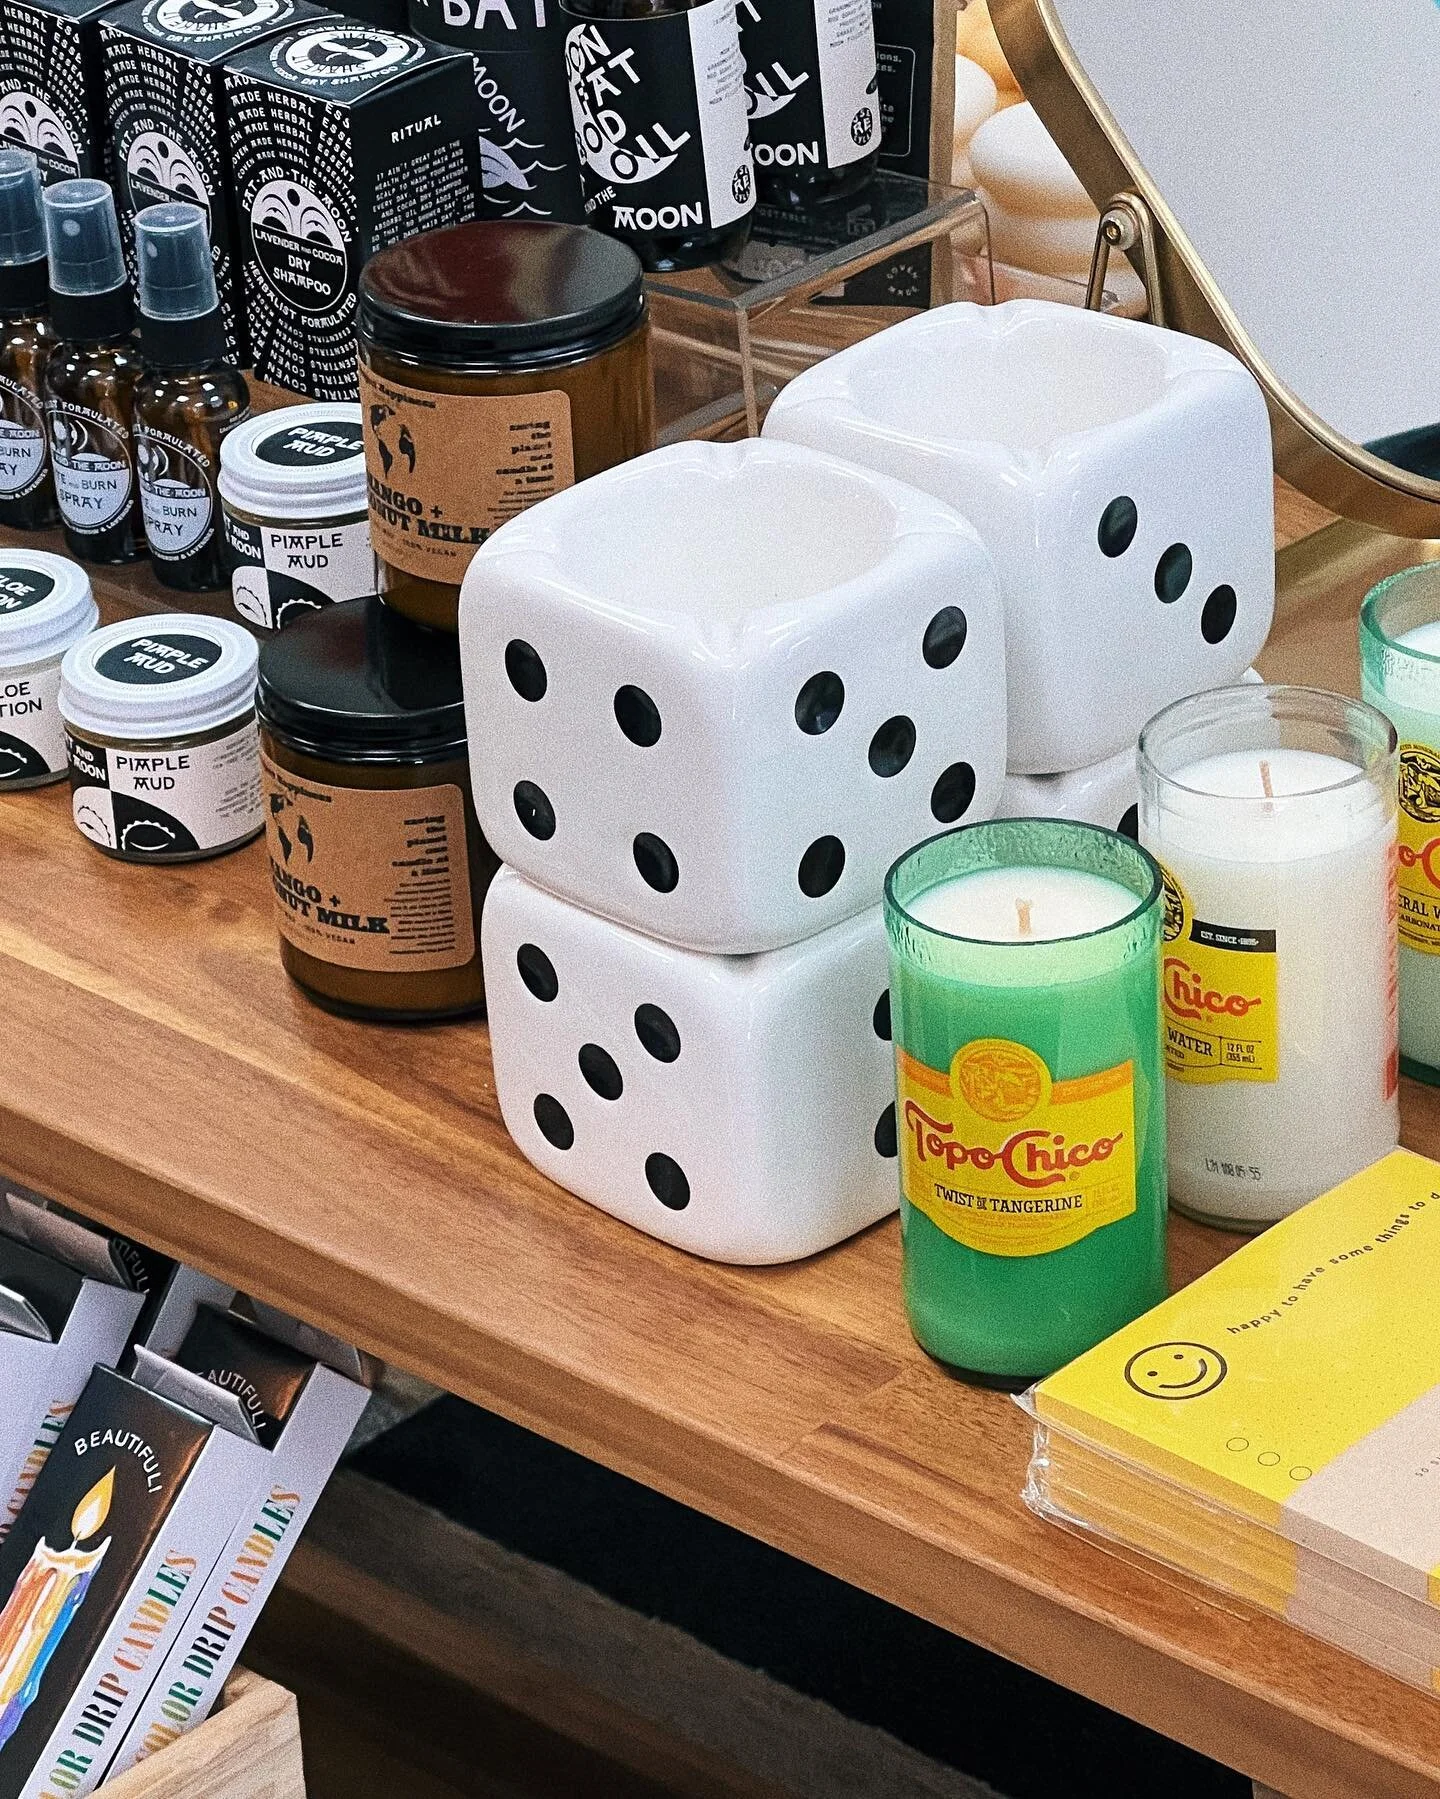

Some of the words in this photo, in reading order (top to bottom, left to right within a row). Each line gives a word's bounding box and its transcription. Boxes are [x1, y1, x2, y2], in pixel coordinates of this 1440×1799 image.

[4, 6, 48, 34] HERBAL
[7, 22, 46, 46] HERBAL
[10, 36, 45, 59] HERBAL
[106, 44, 133, 58] MADE
[137, 45, 179, 73] HERBAL
[330, 65, 399, 86] SHAMPOO
[230, 91, 262, 107] MADE
[267, 91, 315, 118] HERBAL
[27, 81, 51, 106] THE
[55, 106, 85, 155] MOON
[238, 107, 266, 122] MADE
[270, 108, 313, 132] HERBAL
[391, 114, 442, 143] RITUAL
[244, 121, 270, 135] MADE
[273, 122, 312, 145] HERBAL
[118, 130, 132, 162] FAT
[132, 118, 155, 134] AND
[160, 121, 184, 146] THE
[187, 147, 216, 197] MOON
[250, 137, 273, 149] MADE
[276, 137, 310, 157] HERBAL
[610, 122, 691, 180] OIL
[278, 151, 309, 169] HERBAL
[411, 153, 430, 167] GREAT
[242, 180, 257, 212] FAT
[259, 165, 284, 183] AND
[291, 168, 317, 193] THE
[322, 193, 353, 243] MOON
[376, 188, 396, 201] SCALP
[594, 185, 617, 205] THE
[612, 201, 704, 231] MOON
[254, 229, 300, 252] LAVENDER
[312, 248, 344, 266] COCOA
[288, 254, 311, 272] DRY
[273, 267, 332, 296] SHAMPOO
[248, 260, 297, 320] HERBALIST
[301, 292, 357, 329] FORMULATED
[275, 328, 304, 351] COVEN
[270, 349, 306, 378] COVEN
[272, 339, 305, 365] COVEN
[267, 361, 307, 393] COVEN
[62, 401, 130, 439] FORMULATED
[9, 429, 40, 439] MOON
[288, 428, 365, 451] PIMPLE
[144, 426, 211, 468] FORMULATED
[283, 440, 336, 457] MUD
[73, 461, 91, 470] THE
[94, 461, 127, 471] MOON
[81, 479, 117, 490] BURN
[153, 487, 171, 496] THE
[175, 487, 206, 497] MOON
[59, 488, 103, 509] SPRAY
[162, 505, 197, 517] BURN
[232, 528, 250, 541] AND
[271, 532, 344, 550] PIMPLE
[231, 537, 262, 560] MOON
[287, 554, 329, 568] MUD
[123, 652, 176, 674] MUD
[131, 638, 209, 669] PIMPLE
[76, 746, 95, 762] AND
[116, 755, 191, 772] PIMPLE
[72, 754, 107, 781] MOON
[133, 776, 176, 791] MUD
[316, 906, 391, 934] MILK
[1216, 935, 1238, 946] SINCE
[1164, 957, 1262, 1020] Chico
[1167, 1026, 1213, 1057] WATER
[1227, 1042, 1236, 1053] 12
[905, 1100, 1001, 1171] Topo
[1002, 1130, 1124, 1189] Chico
[934, 1183, 975, 1208] TWIST
[990, 1195, 1084, 1213] TANGERINE
[1227, 1309, 1283, 1335] happy
[1281, 1294, 1299, 1307] to
[1293, 1266, 1326, 1291] have
[1329, 1244, 1374, 1265] some
[1375, 1213, 1411, 1244] things
[1409, 1200, 1426, 1211] to
[74, 1428, 163, 1494] BEAUTIFUL!
[182, 1605, 238, 1680] DRIP
[221, 1484, 301, 1606] CANDLES
[72, 1672, 129, 1747] DRIP
[112, 1549, 197, 1673] CANDLES
